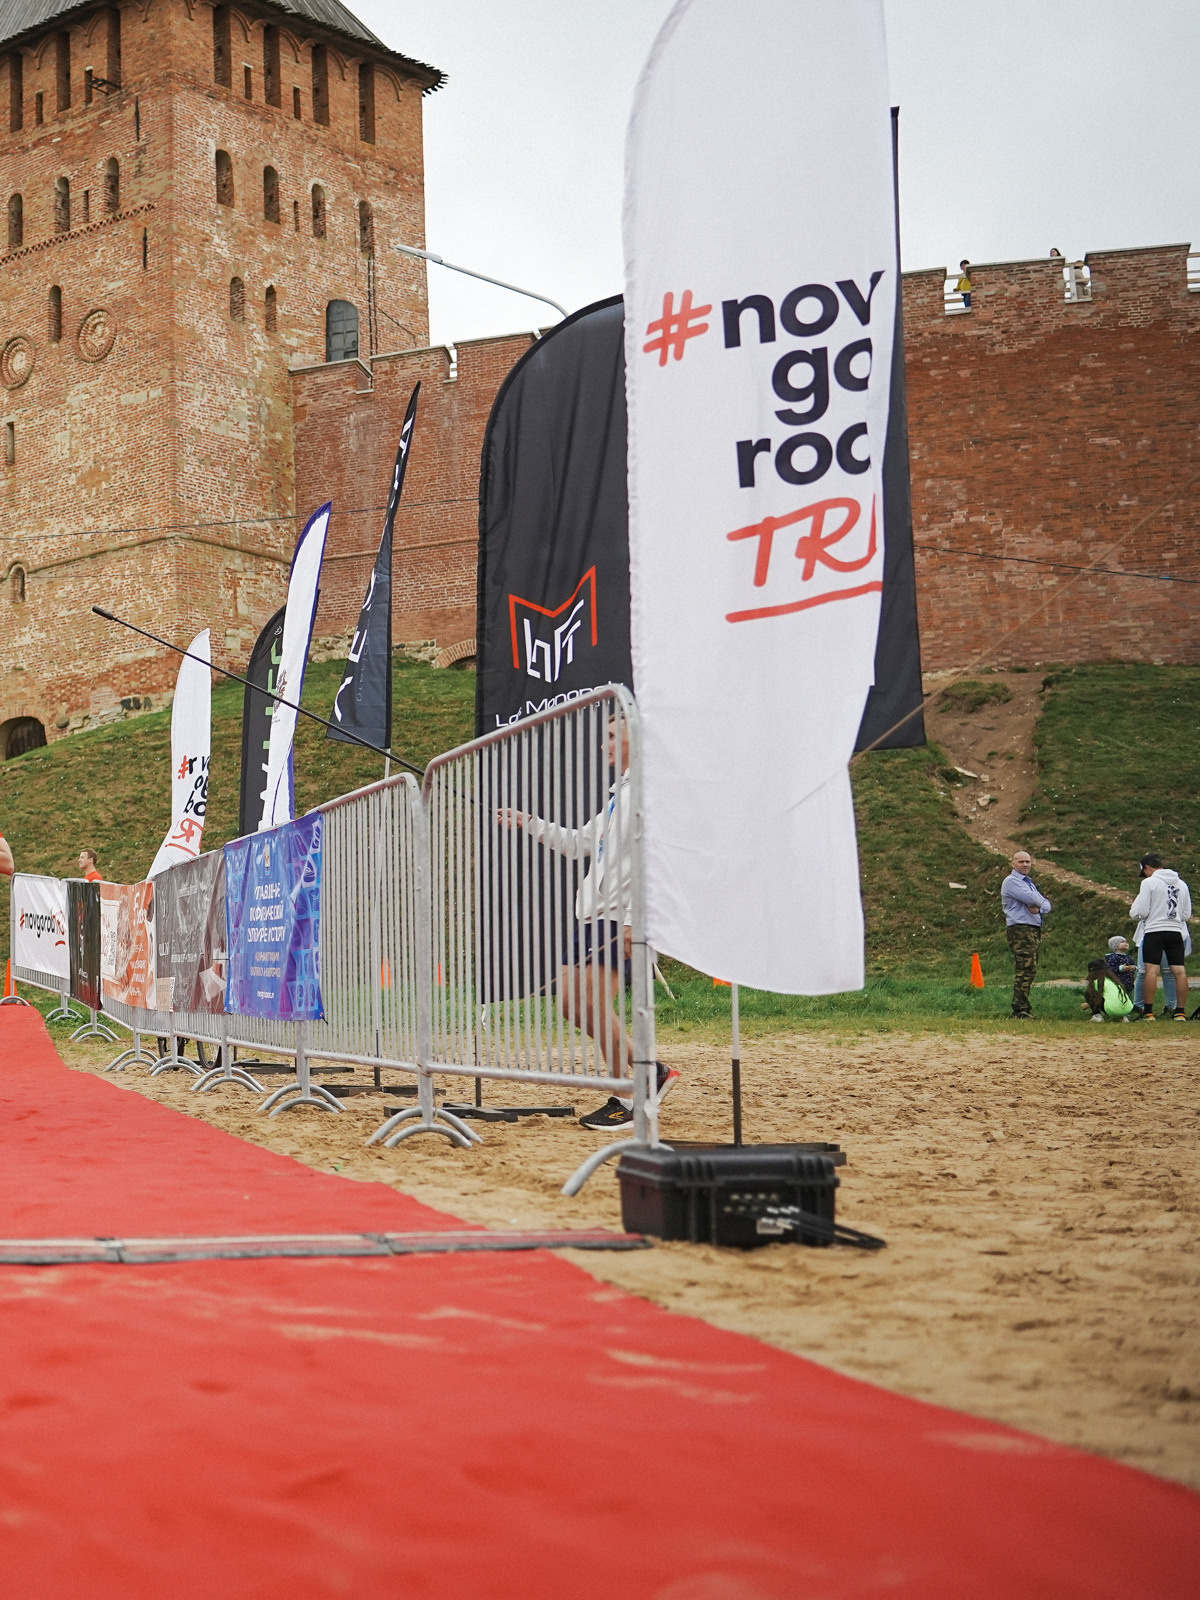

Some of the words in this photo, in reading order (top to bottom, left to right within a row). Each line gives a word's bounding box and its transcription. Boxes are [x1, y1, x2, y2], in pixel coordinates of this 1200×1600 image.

[643, 270, 886, 367] #nov
[772, 337, 873, 426] go
[726, 493, 877, 588] TRI
